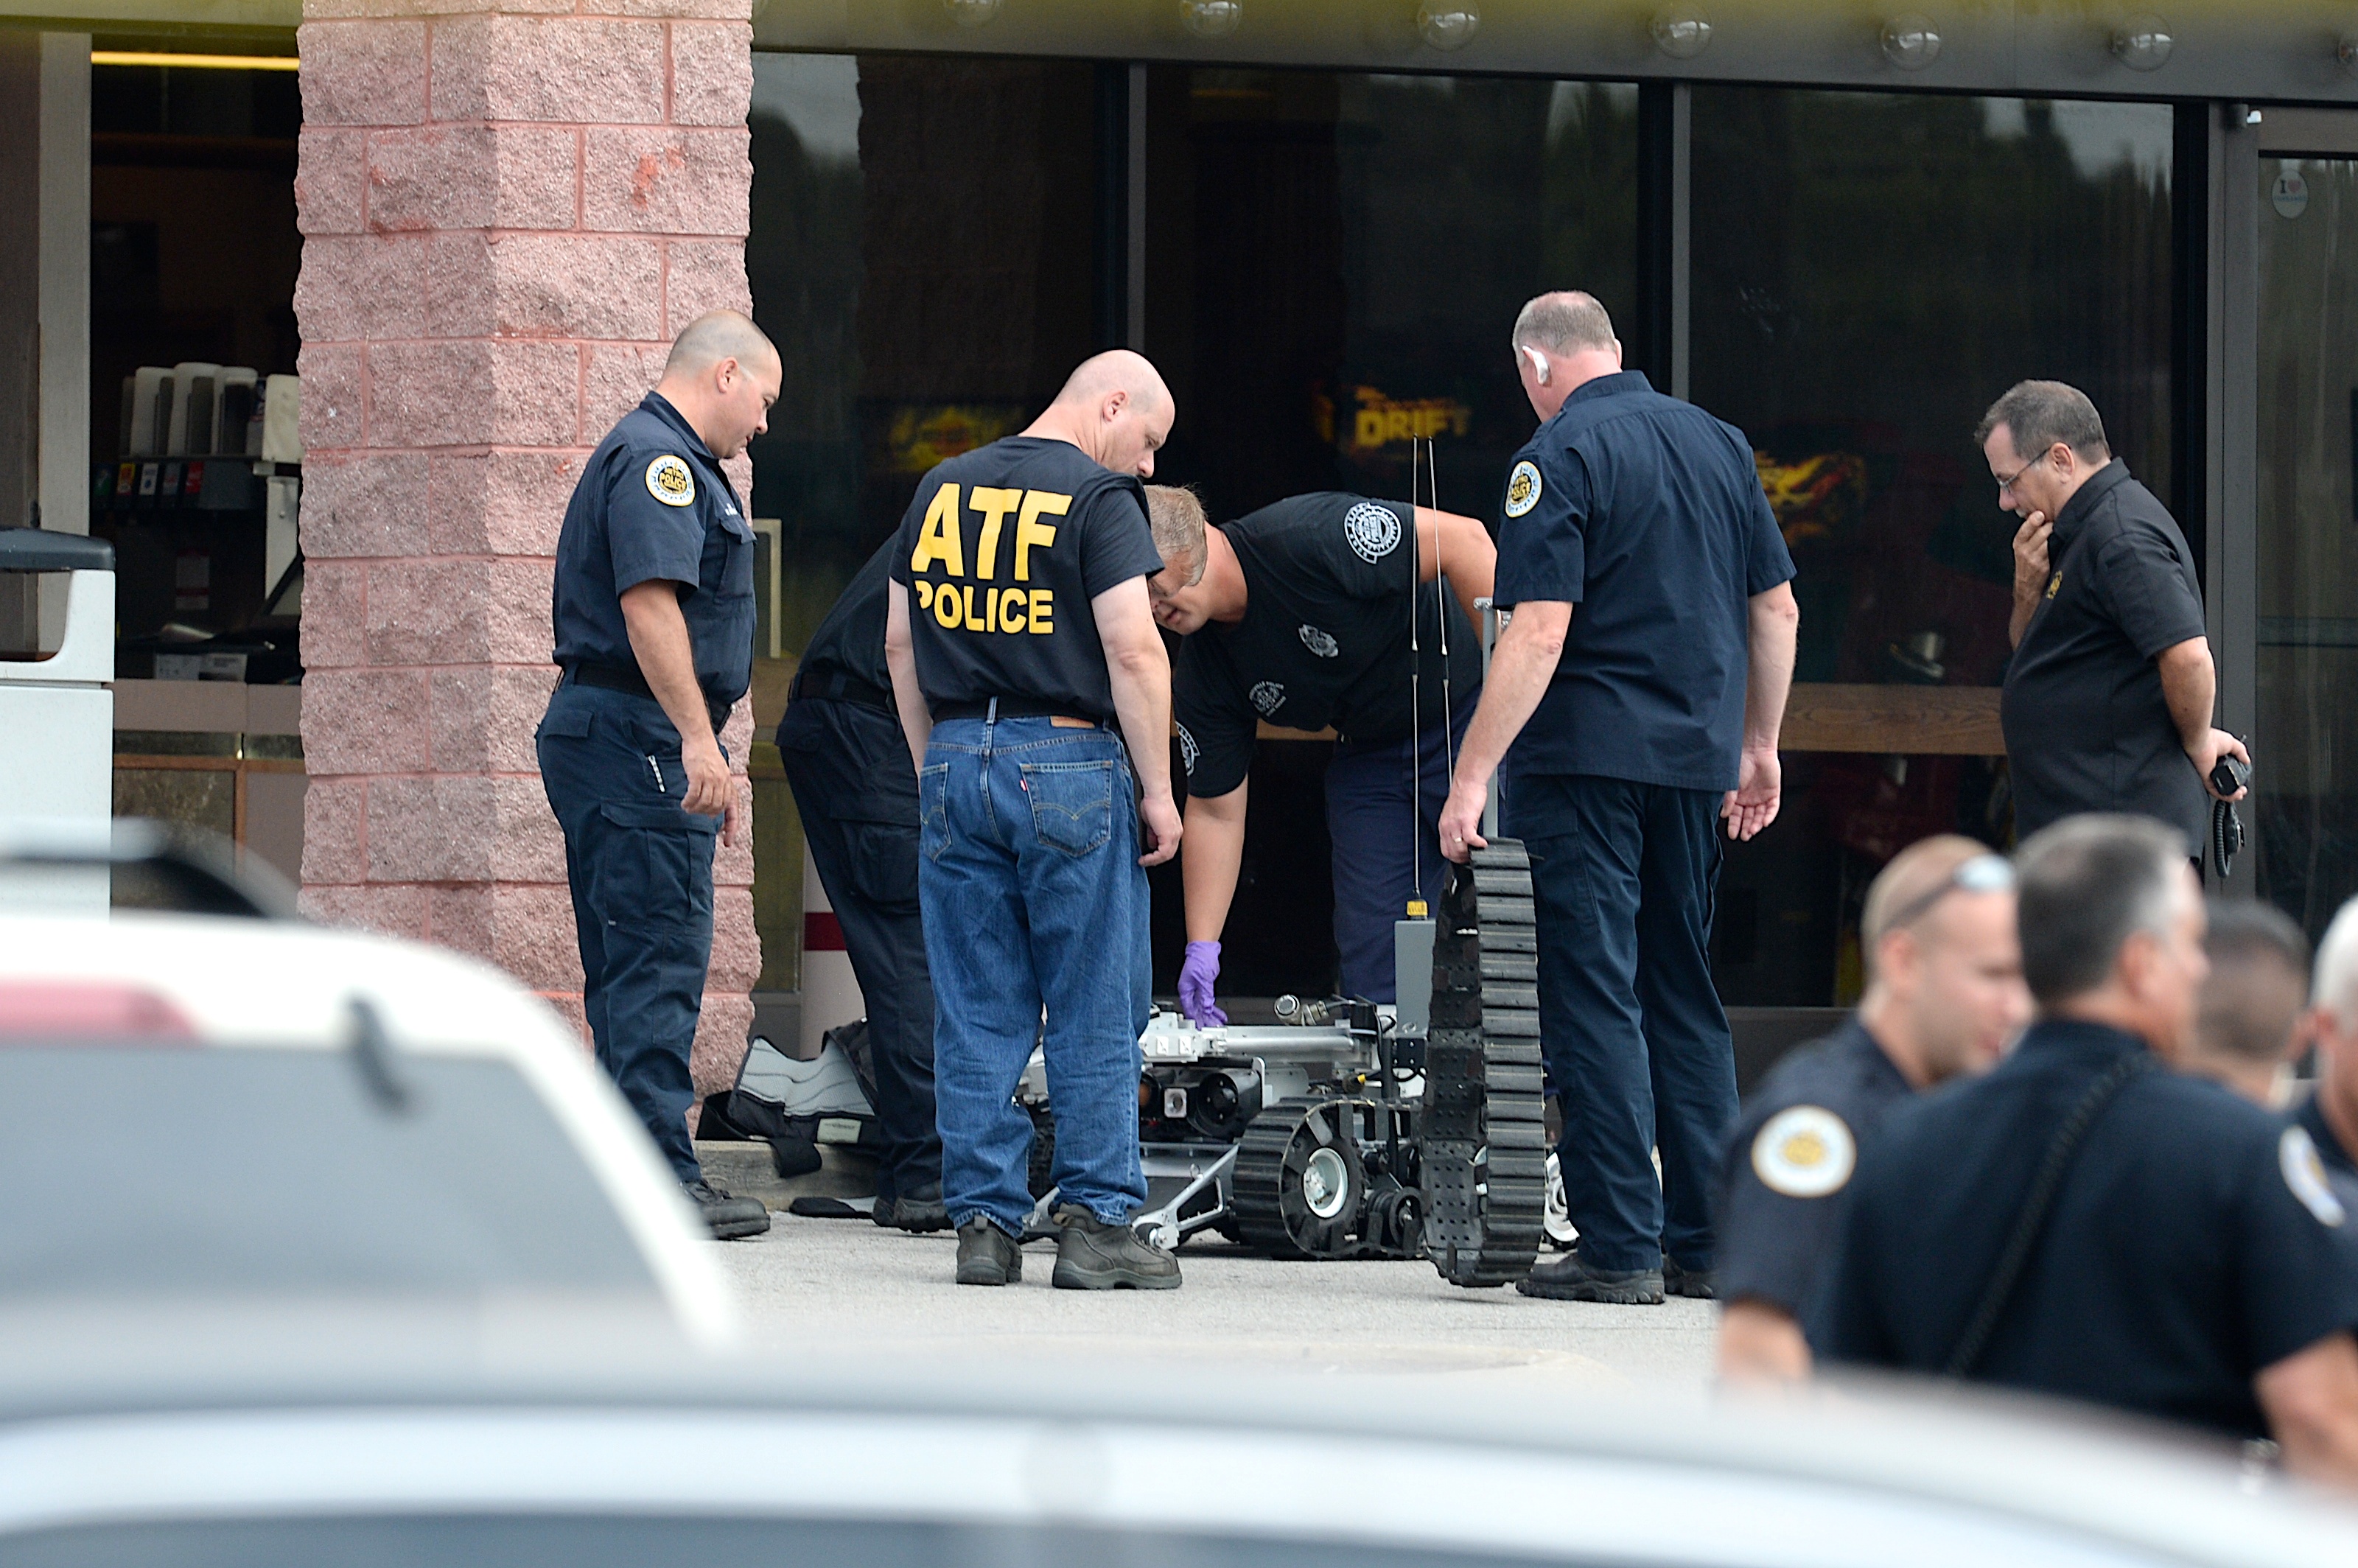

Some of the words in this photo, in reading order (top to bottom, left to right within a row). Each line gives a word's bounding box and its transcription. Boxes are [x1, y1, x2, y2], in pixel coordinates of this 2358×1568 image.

[1355, 408, 1471, 447] DRIFT
[911, 482, 1073, 581] ATF
[914, 580, 1054, 634] POLICE
